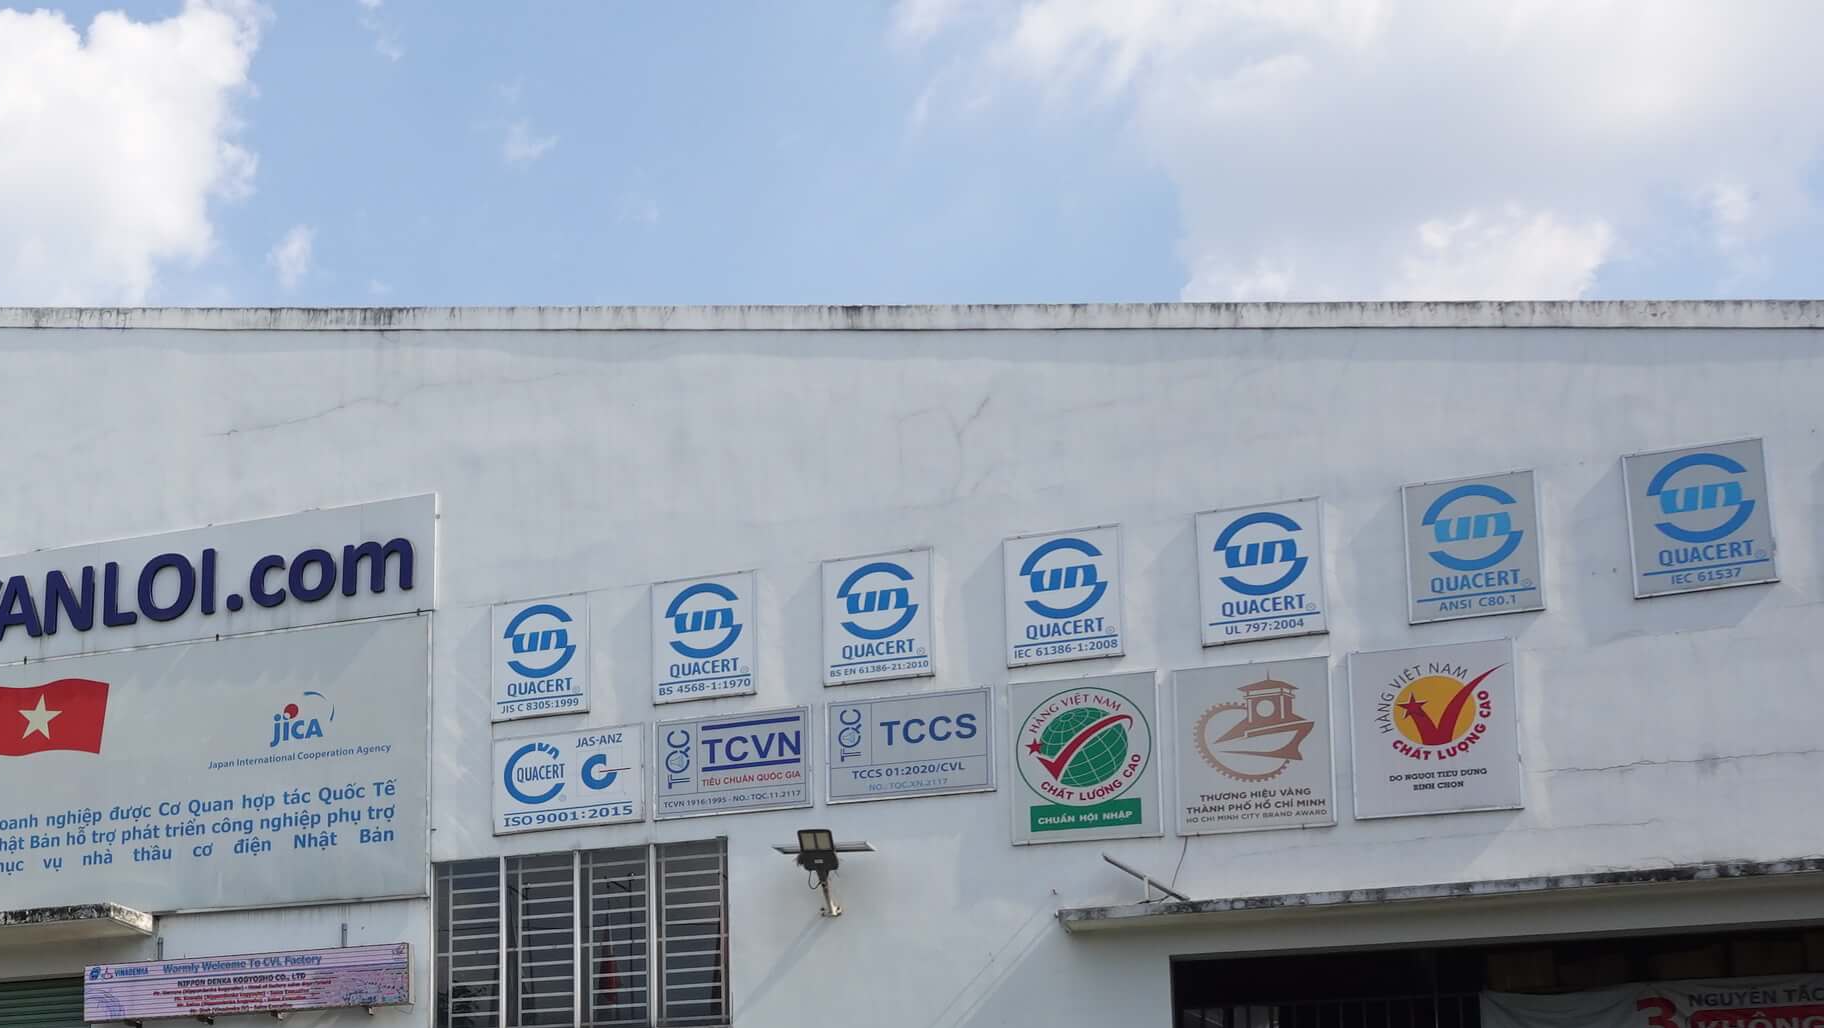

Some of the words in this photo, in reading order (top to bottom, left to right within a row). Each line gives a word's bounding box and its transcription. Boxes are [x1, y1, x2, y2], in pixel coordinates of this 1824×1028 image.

[1658, 539, 1754, 566] QUACERT
[1430, 569, 1520, 593] QUACERT
[1670, 572, 1693, 586] IEC
[1697, 567, 1742, 583] 61537
[1221, 593, 1306, 617] QUACERT
[1439, 599, 1474, 613] ANSI
[1478, 594, 1517, 609] C80.1
[1025, 617, 1105, 641] QUACERT
[1225, 624, 1242, 635] UL
[1244, 618, 1305, 633] 797:2004
[842, 639, 915, 660] QUACERT
[1013, 647, 1033, 660] IEC
[1035, 639, 1119, 657] 61386-1:2008
[670, 657, 739, 678] QUACERT
[830, 668, 841, 678] BS
[843, 666, 856, 677] EN
[858, 659, 929, 675] 61386-21:2010
[507, 677, 572, 697] QUACERT
[658, 686, 673, 696] BS
[677, 678, 751, 694] 4568-1:1970
[501, 703, 515, 714] JIS
[517, 702, 524, 712] C
[526, 698, 579, 711] 8305:1999
[576, 733, 623, 748] JAS-ANZ
[880, 713, 977, 747] TCCS
[208, 759, 234, 770] Japan
[237, 752, 295, 767] International
[297, 747, 355, 764] Cooperation
[356, 744, 392, 759] Agency
[702, 730, 801, 764] TCVN
[517, 763, 566, 782] QUACERT
[853, 768, 883, 780] TCCS
[885, 762, 966, 777] 01:2020/CVL
[46, 807, 102, 829] nghiệp
[109, 803, 151, 821] được
[158, 801, 181, 817] Cơ
[187, 798, 233, 818] Quan
[242, 793, 276, 813] hợp
[283, 789, 310, 806] tác
[318, 783, 366, 805] Quốc
[373, 778, 398, 797] Tế
[504, 815, 533, 827] ISO
[537, 805, 633, 825] 9001:2015
[1689, 987, 1776, 1007] NGUYÊN
